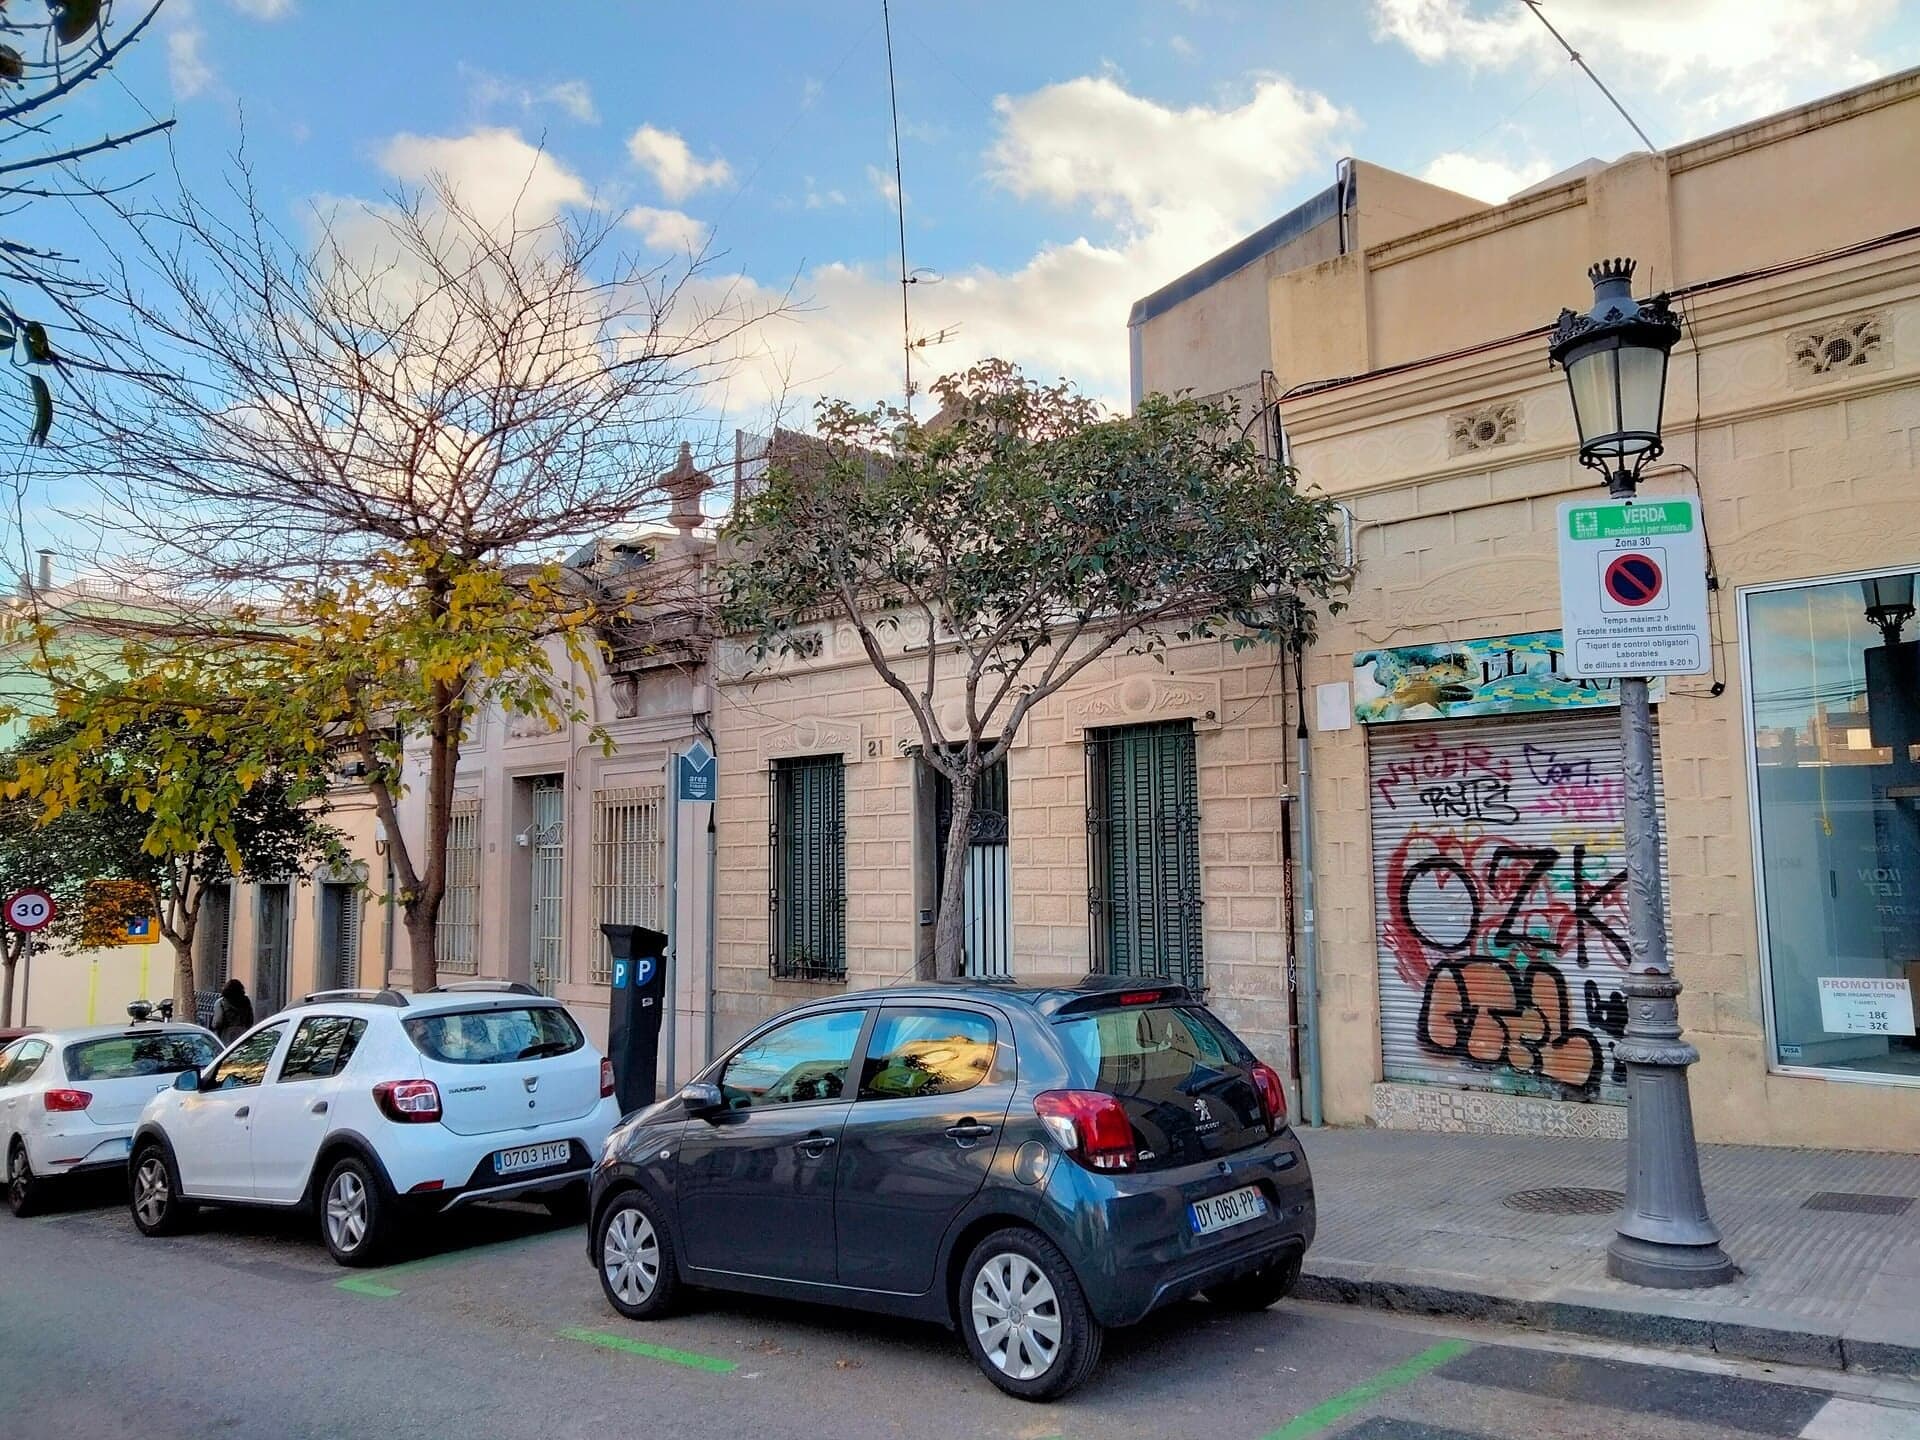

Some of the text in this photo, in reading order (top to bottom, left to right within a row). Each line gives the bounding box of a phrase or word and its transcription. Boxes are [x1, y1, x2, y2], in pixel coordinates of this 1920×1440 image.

[1622, 507, 1667, 523] VERDA
[1604, 526, 1641, 536] Residents
[1646, 526, 1660, 535] per
[1660, 523, 1687, 533] minuts
[1615, 537, 1651, 547] Zona 30
[1603, 616, 1628, 625] Temps
[1577, 627, 1608, 636] Excepte
[1609, 626, 1645, 634] residents
[1665, 624, 1696, 632] distintiu
[1586, 639, 1689, 650] Tiquet de control obligatori
[1616, 650, 1659, 658] Laborables
[1480, 649, 1527, 687] EL
[1584, 662, 1594, 670] de
[1595, 661, 1621, 669] dilluns
[1630, 659, 1668, 668] divendres
[868, 739, 883, 757] 21
[16, 903, 44, 917] 30
[615, 963, 625, 985] P
[638, 960, 651, 981] P
[1822, 980, 1906, 990] PROMOTION
[1868, 1011, 1888, 1020] 18€
[1869, 1022, 1889, 1031] 32€
[504, 1144, 567, 1167] 0703 HYG
